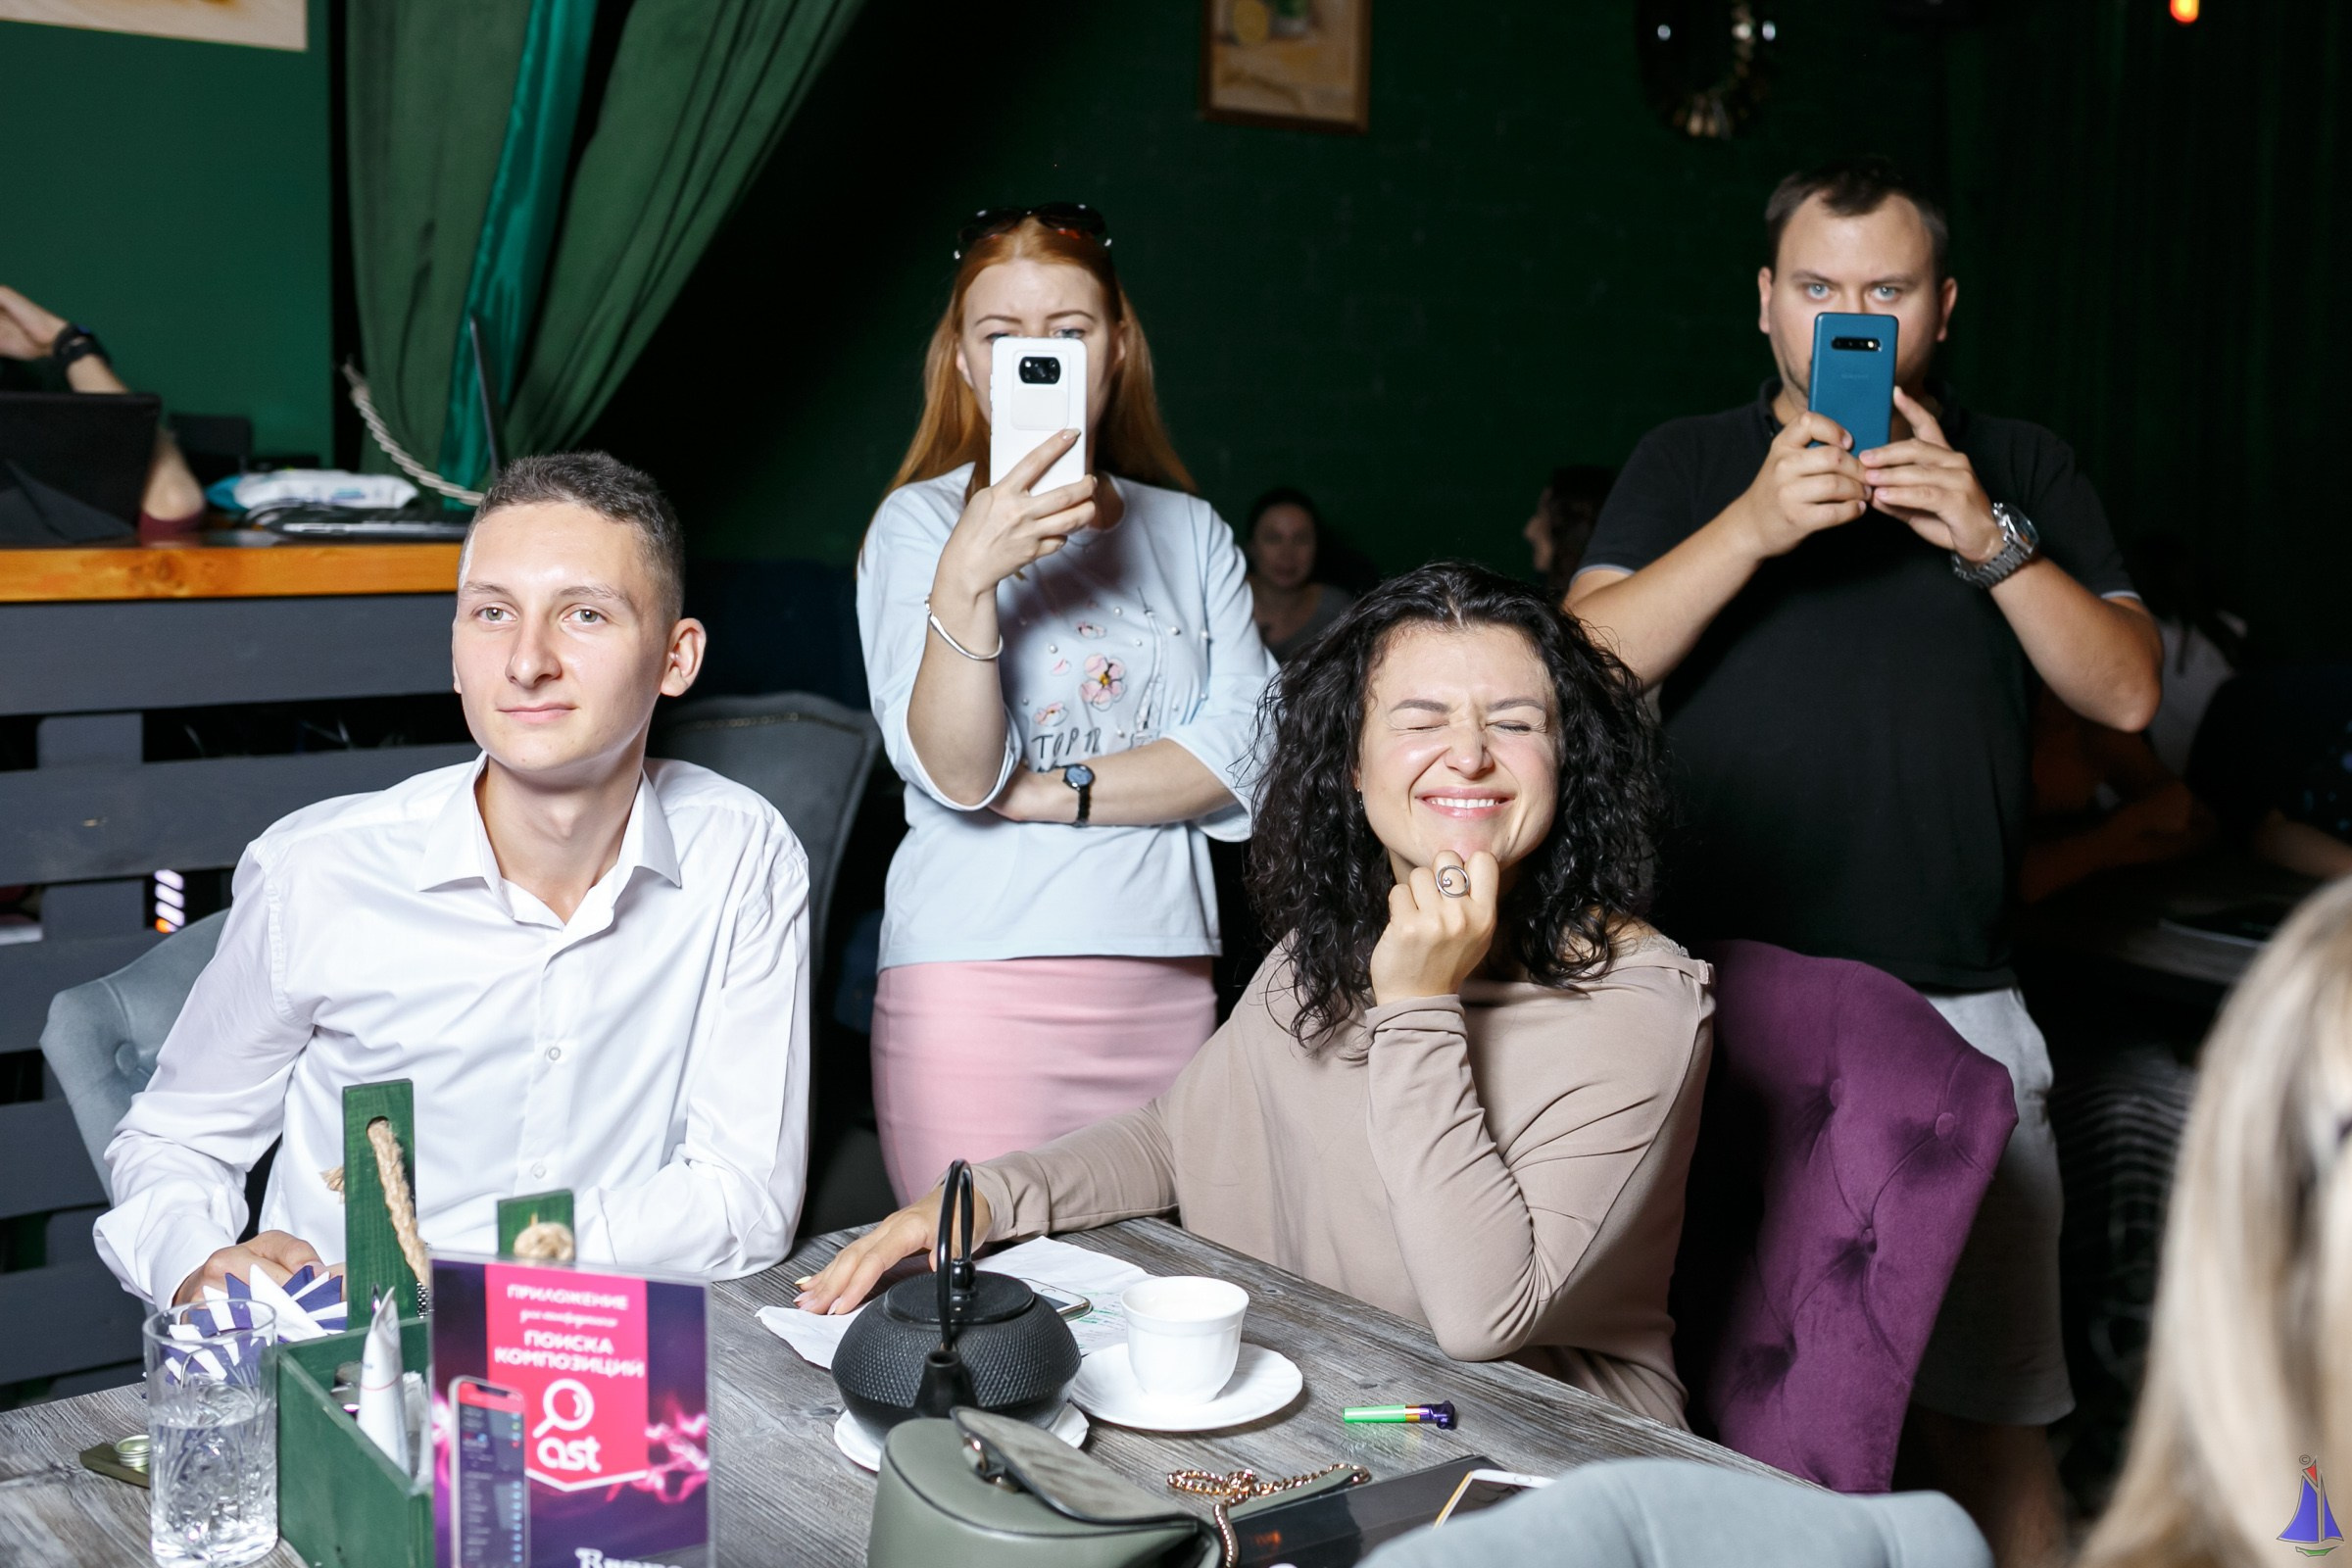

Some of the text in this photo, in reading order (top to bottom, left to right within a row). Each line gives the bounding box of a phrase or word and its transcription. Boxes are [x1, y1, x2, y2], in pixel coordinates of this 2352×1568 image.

[507, 1284, 628, 1310] ПРИЛОЖЕНИЕ
[523, 1329, 614, 1354] ПОИСКА
[536, 1436, 602, 1473] ast
